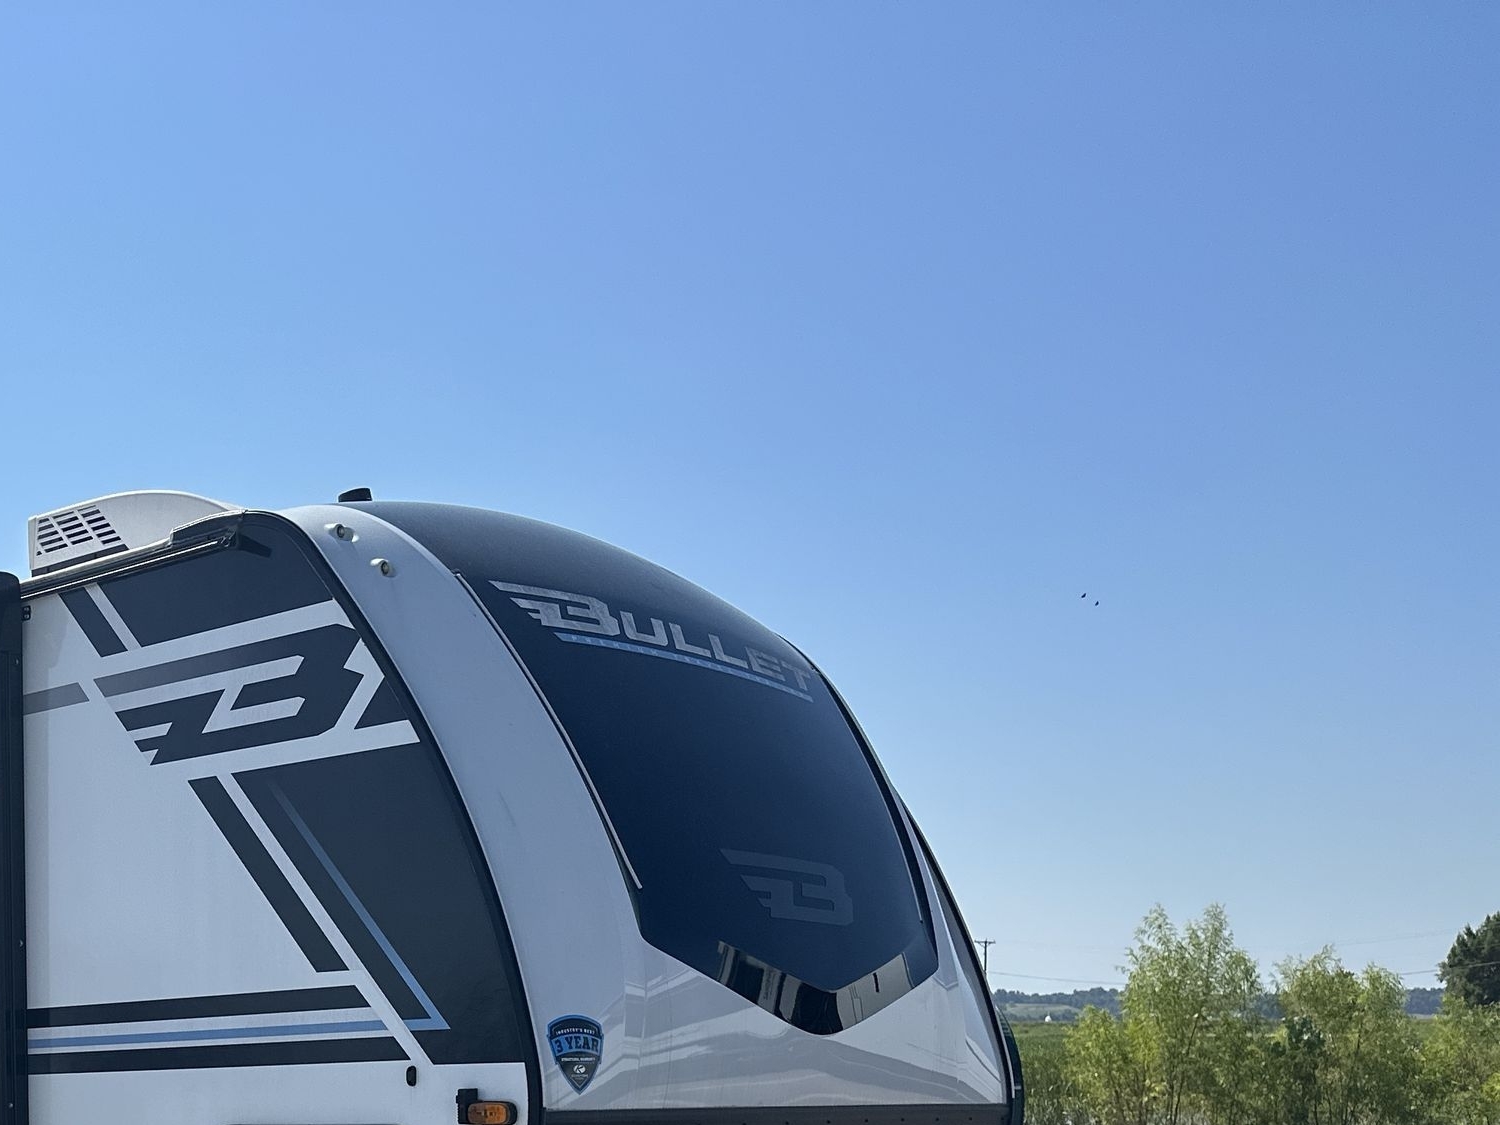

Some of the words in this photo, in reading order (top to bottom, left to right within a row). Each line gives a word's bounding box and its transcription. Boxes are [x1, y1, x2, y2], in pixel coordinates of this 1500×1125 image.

[488, 580, 815, 692] BULLET
[554, 1038, 564, 1053] 3
[564, 1035, 599, 1053] YEAR
